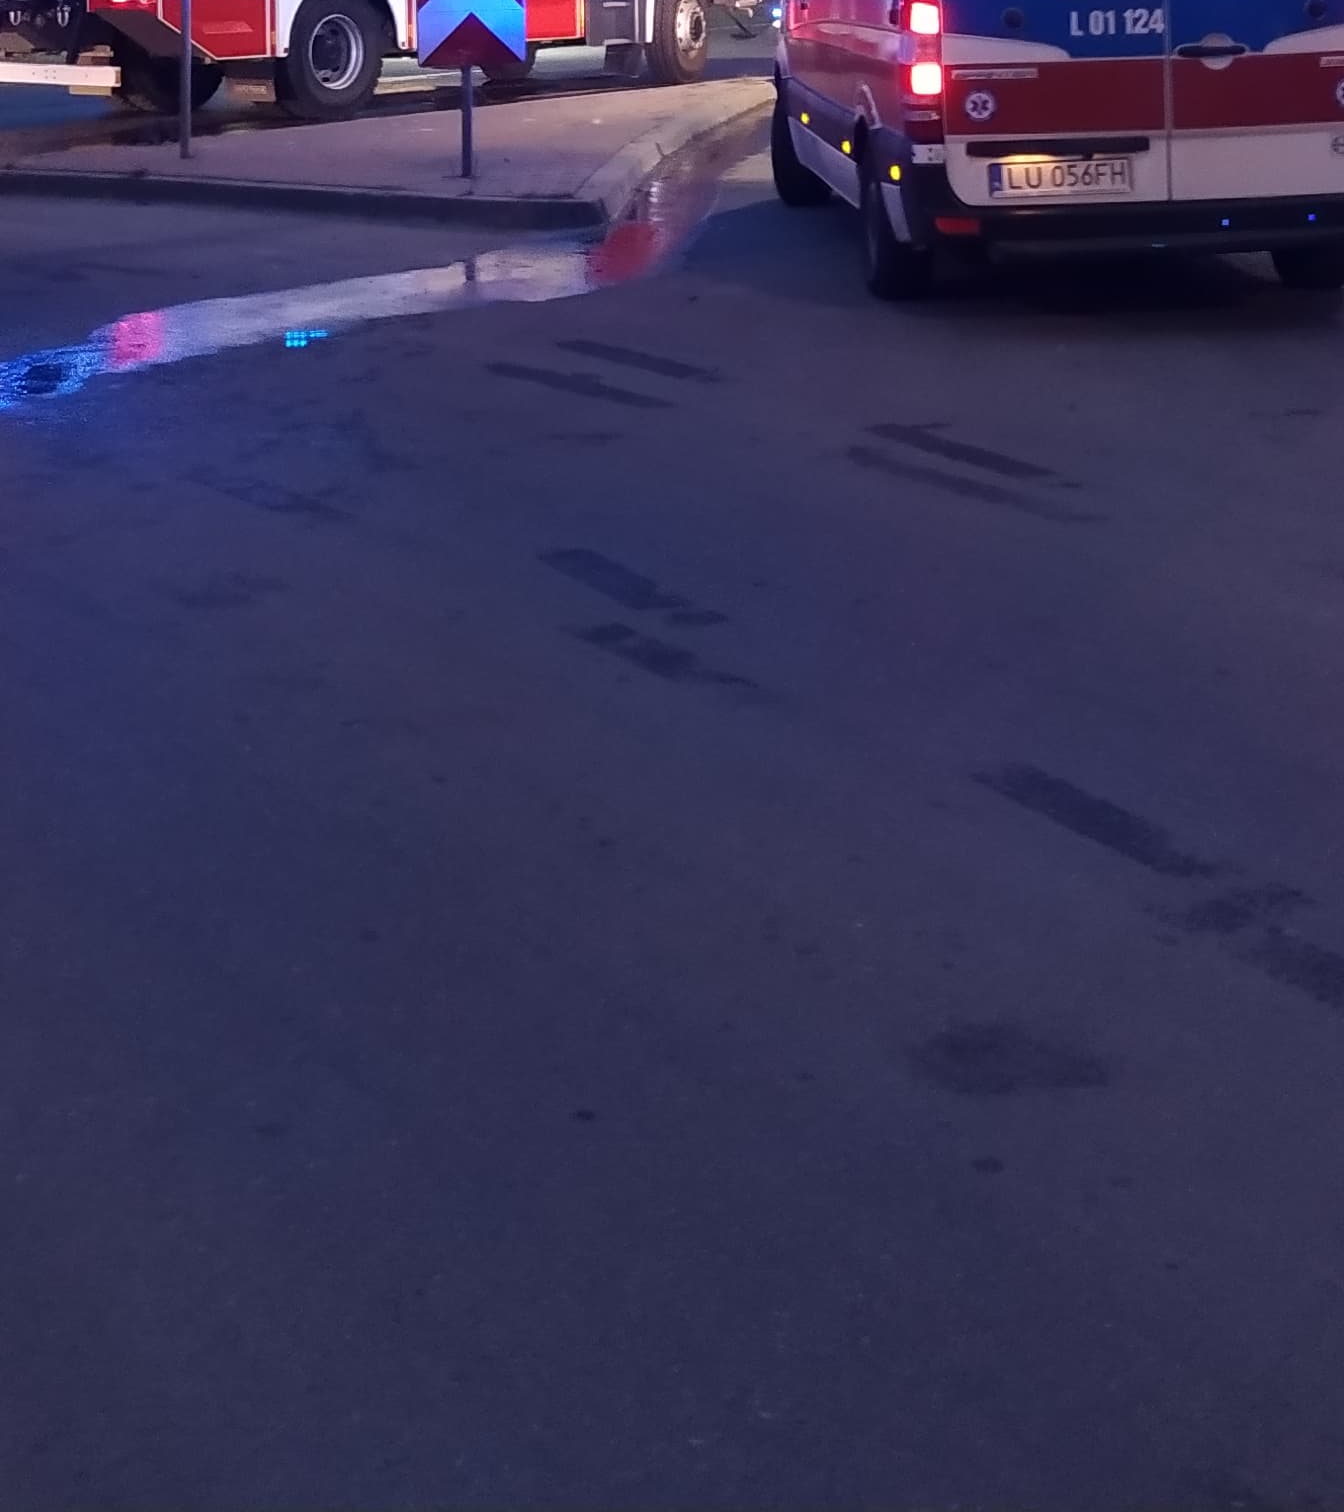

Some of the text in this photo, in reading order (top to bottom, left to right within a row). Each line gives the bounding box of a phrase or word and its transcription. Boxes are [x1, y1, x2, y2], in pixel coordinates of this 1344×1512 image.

[1123, 8, 1165, 34] 124
[1008, 161, 1126, 189] LU 056FH
